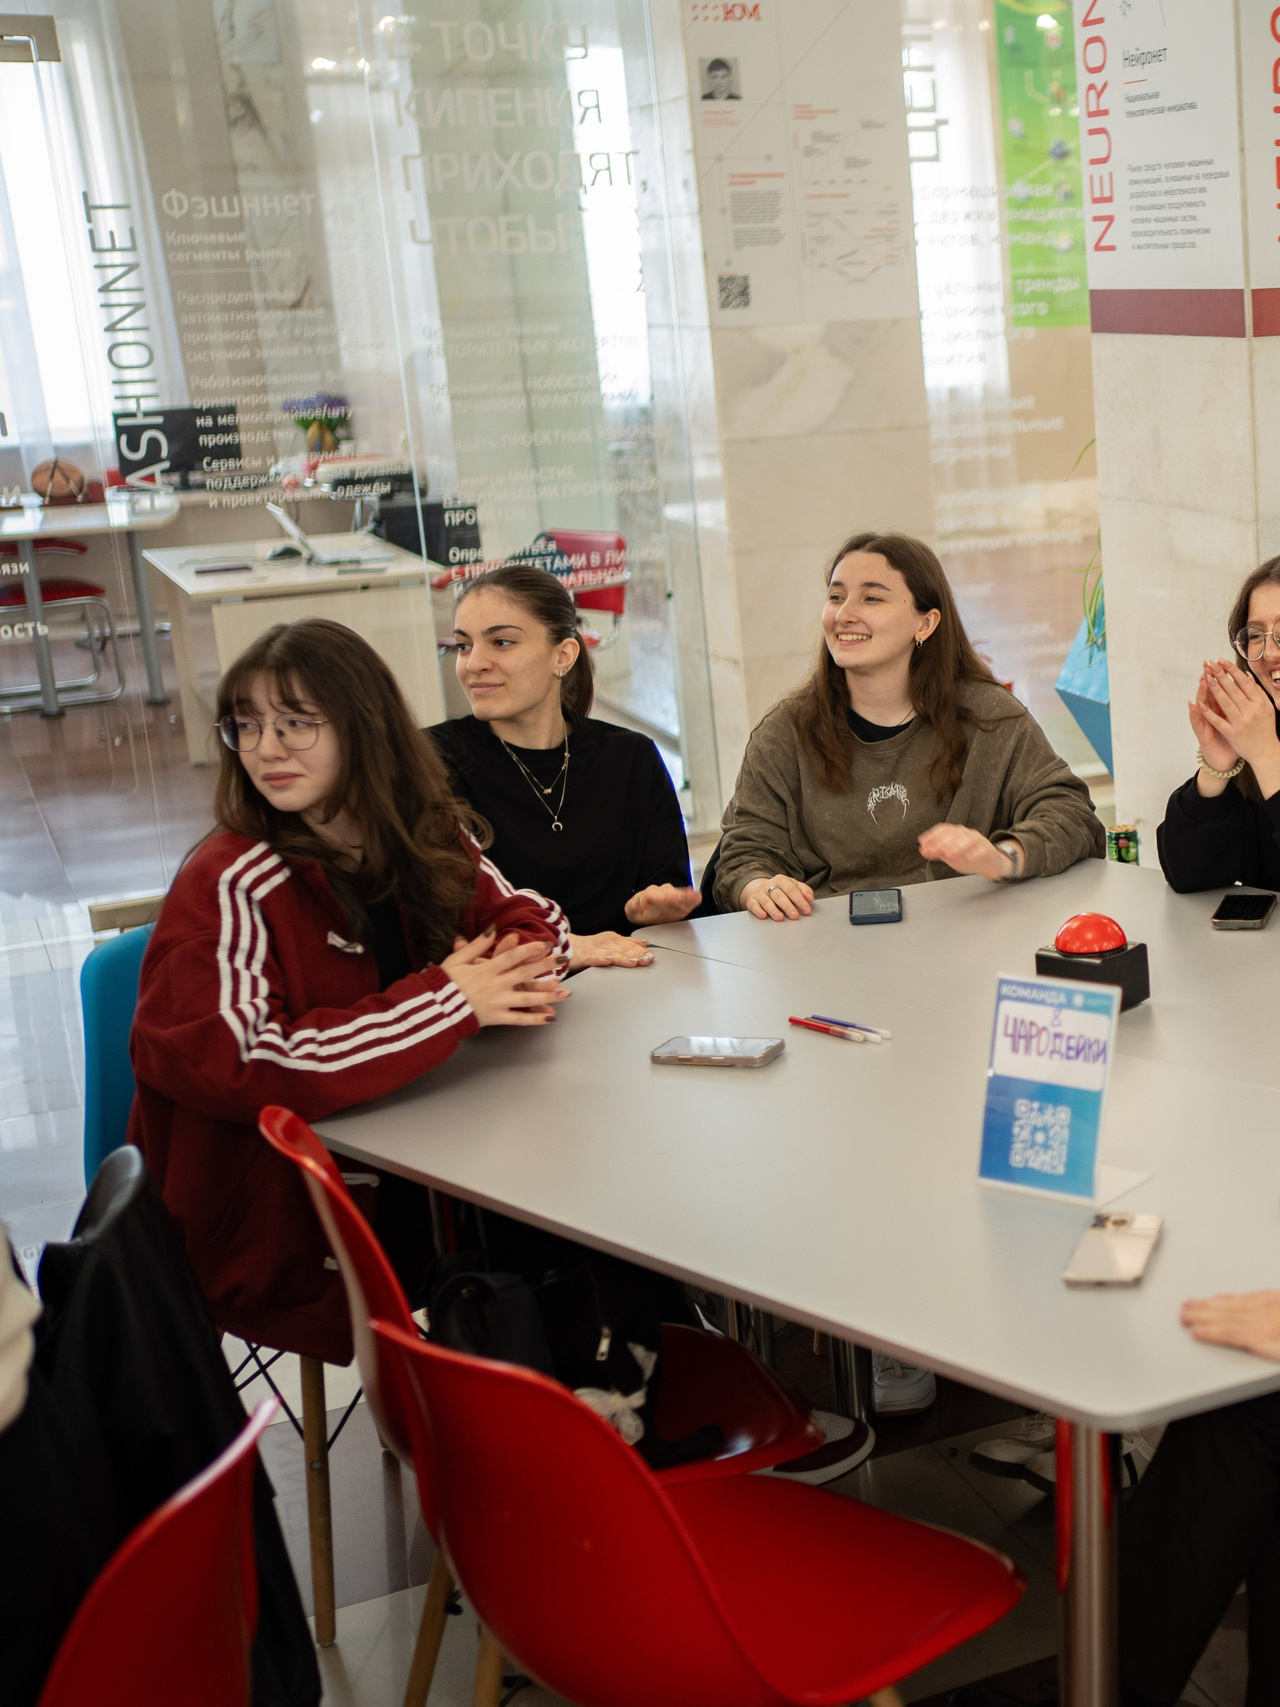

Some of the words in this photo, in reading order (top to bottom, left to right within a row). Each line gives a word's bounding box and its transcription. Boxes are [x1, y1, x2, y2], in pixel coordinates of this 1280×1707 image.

[430, 20, 588, 62] ТОЧКУ
[1122, 46, 1168, 69] Нейронет
[394, 86, 602, 128] КИПЕНИЯ
[161, 187, 316, 220] Фэшннет
[165, 229, 247, 246] Ключевые
[168, 247, 241, 264] сегменты
[243, 246, 293, 264] рынка
[180, 307, 327, 326] автоматизированные
[294, 323, 341, 339] едино
[196, 415, 214, 429] на
[501, 425, 593, 448] ПРОЕКТНЫЕ
[202, 455, 263, 474] Сервисы
[508, 463, 577, 482] УЧАСТИЕ
[209, 498, 218, 509] и
[337, 481, 392, 500] одежды
[1001, 983, 1067, 1006] КОМАНДА
[1003, 1014, 1108, 1066] ЧАРОДЕЙКИ
